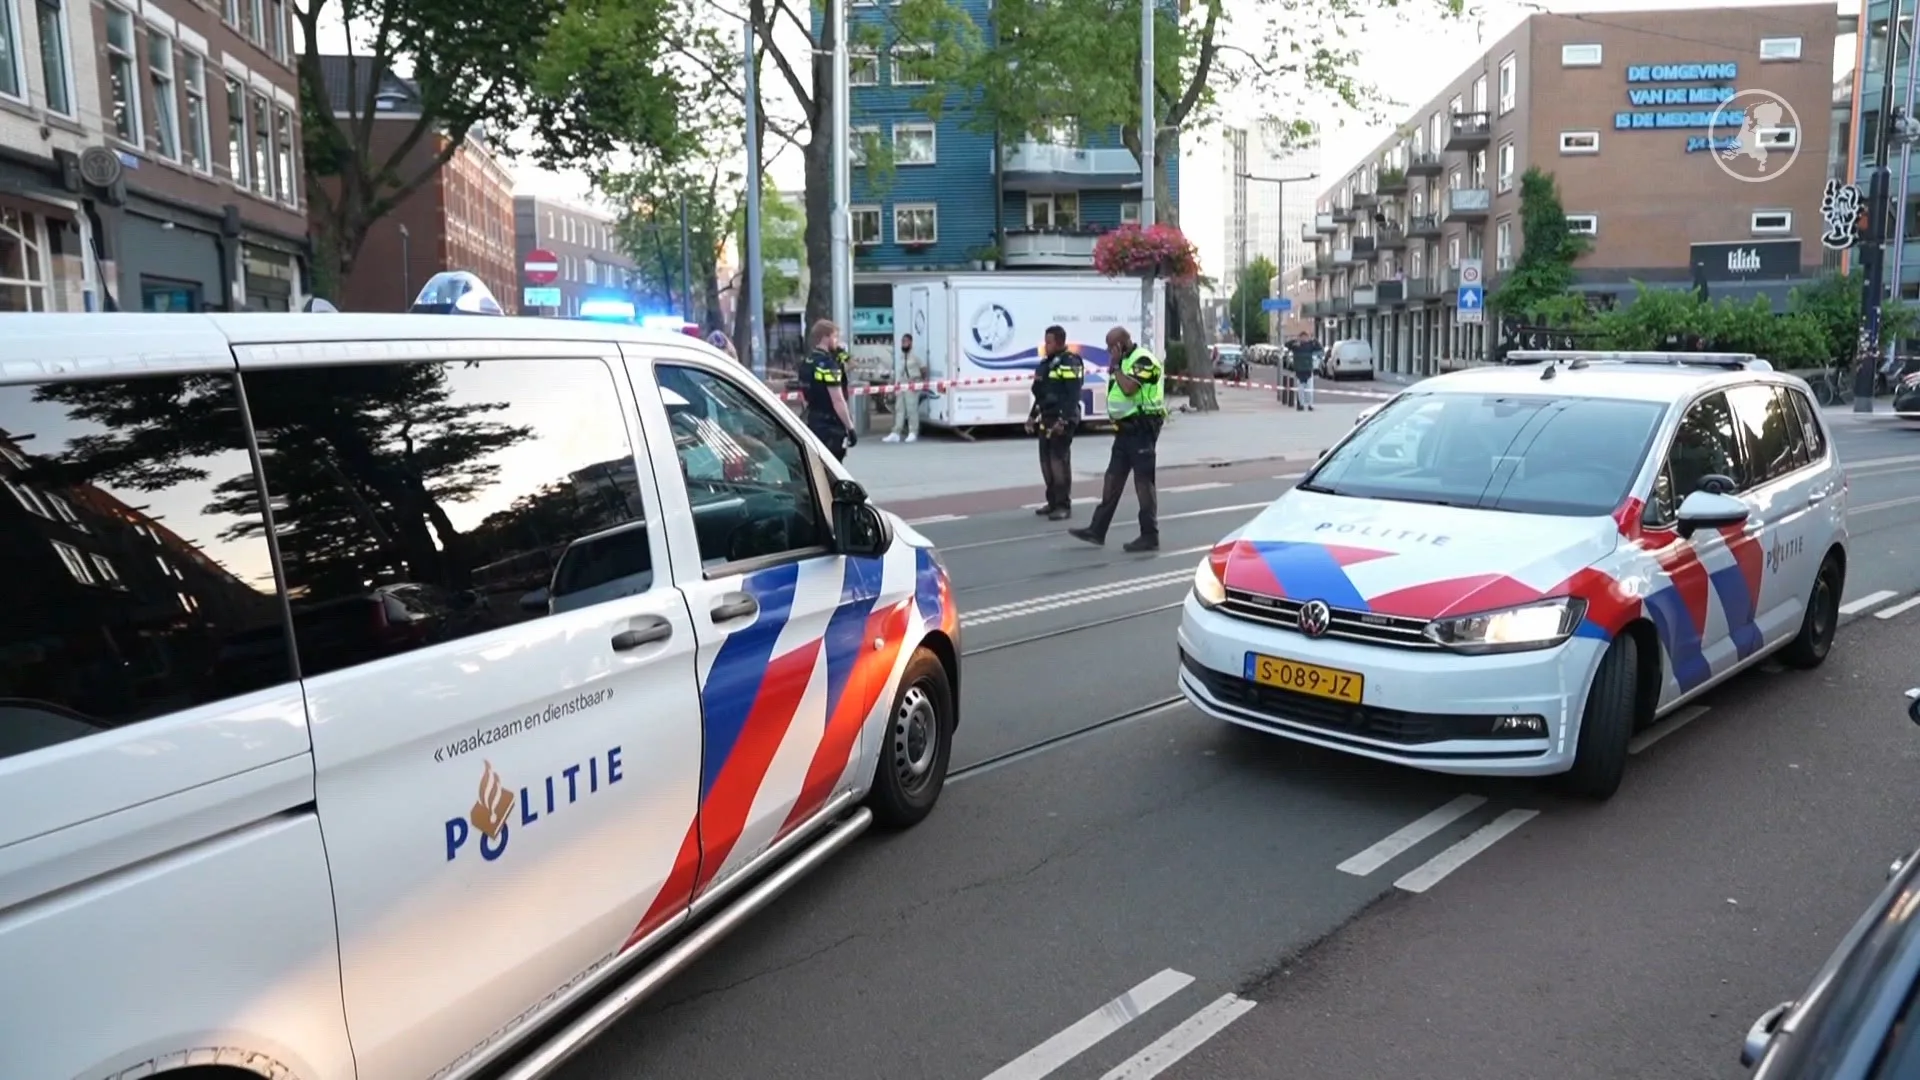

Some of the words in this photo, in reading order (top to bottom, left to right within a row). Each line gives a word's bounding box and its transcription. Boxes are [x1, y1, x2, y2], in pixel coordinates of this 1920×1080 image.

[1628, 66, 1650, 81] DE
[1651, 64, 1737, 80] OMGEVING
[1629, 89, 1663, 105] VAN
[1665, 88, 1687, 104] DE
[1688, 87, 1734, 103] MENS
[1615, 113, 1631, 128] IS
[1632, 112, 1654, 127] DE
[1656, 110, 1744, 127] MEDEMENS
[1314, 522, 1451, 547] POLITIE
[1766, 535, 1804, 574] POLITIE
[1261, 660, 1352, 697] S-089-JZ
[446, 719, 523, 758] waakzaam
[524, 712, 541, 729] en
[543, 688, 606, 723] dienstbaar
[445, 745, 624, 862] POLITIE
